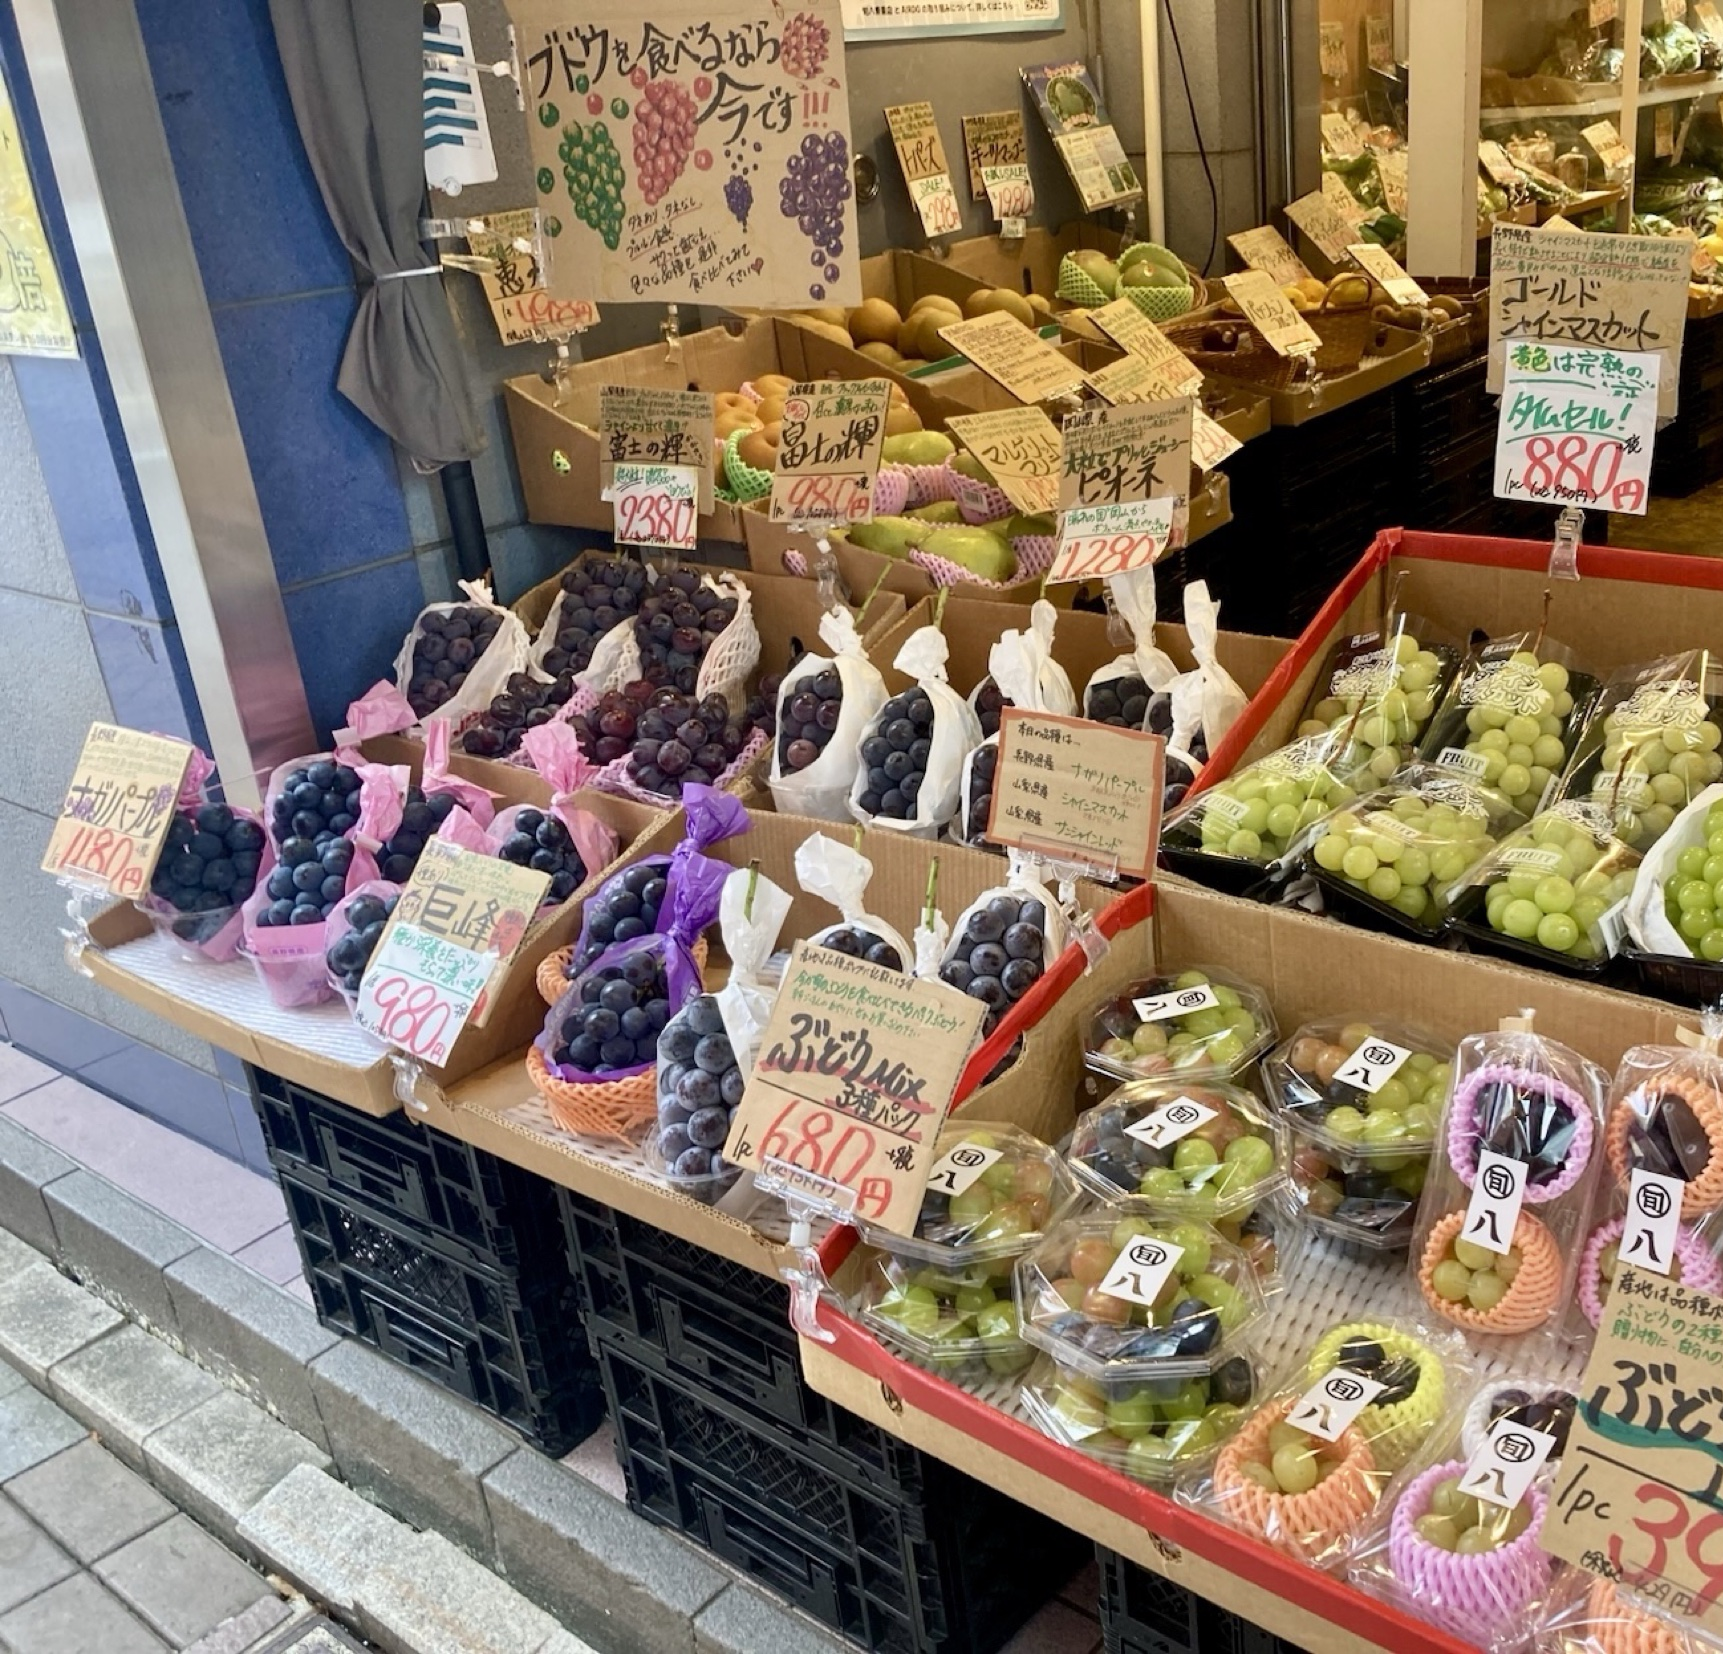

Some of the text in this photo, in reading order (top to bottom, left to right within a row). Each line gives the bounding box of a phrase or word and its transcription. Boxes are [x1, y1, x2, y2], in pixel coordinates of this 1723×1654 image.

[525, 20, 781, 99] ブドウを食べるなら
[1500, 275, 1601, 307] ゴールド
[1499, 307, 1661, 350] シャインマスカット
[1079, 455, 1165, 504] ピオーネ
[1441, 752, 1485, 771] FRUIT
[420, 882, 502, 952] 巨峰
